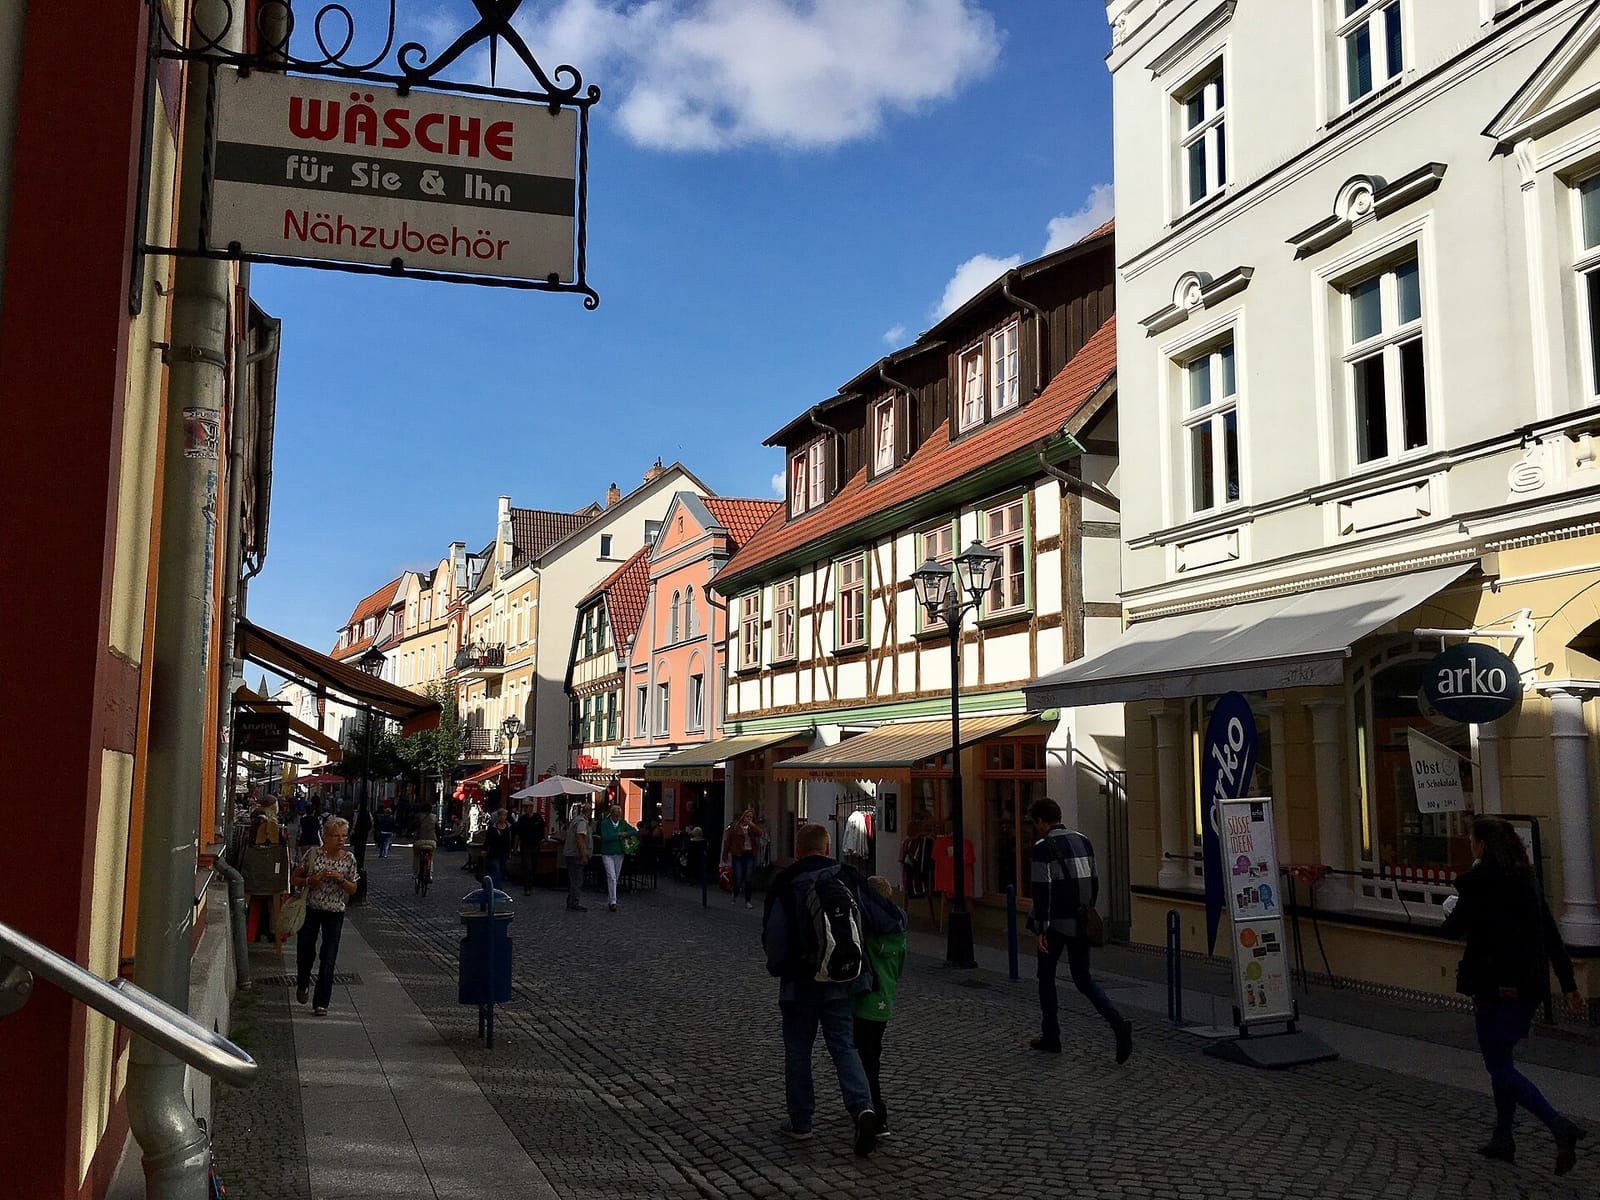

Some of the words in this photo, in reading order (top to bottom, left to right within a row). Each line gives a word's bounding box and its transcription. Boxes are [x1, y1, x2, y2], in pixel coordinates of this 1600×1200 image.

[289, 91, 513, 161] WÄSCHE
[286, 155, 333, 184] für
[350, 162, 402, 191] Sie
[419, 169, 446, 196] &
[464, 173, 511, 203] Ihn
[283, 208, 510, 261] Nähzubehör
[1437, 657, 1507, 695] arko
[1416, 760, 1440, 775] Obst
[1418, 780, 1425, 788] in
[1427, 778, 1458, 788] Schokolade
[1227, 815, 1251, 836] SÜSSE
[1230, 834, 1254, 854] IDEEN
